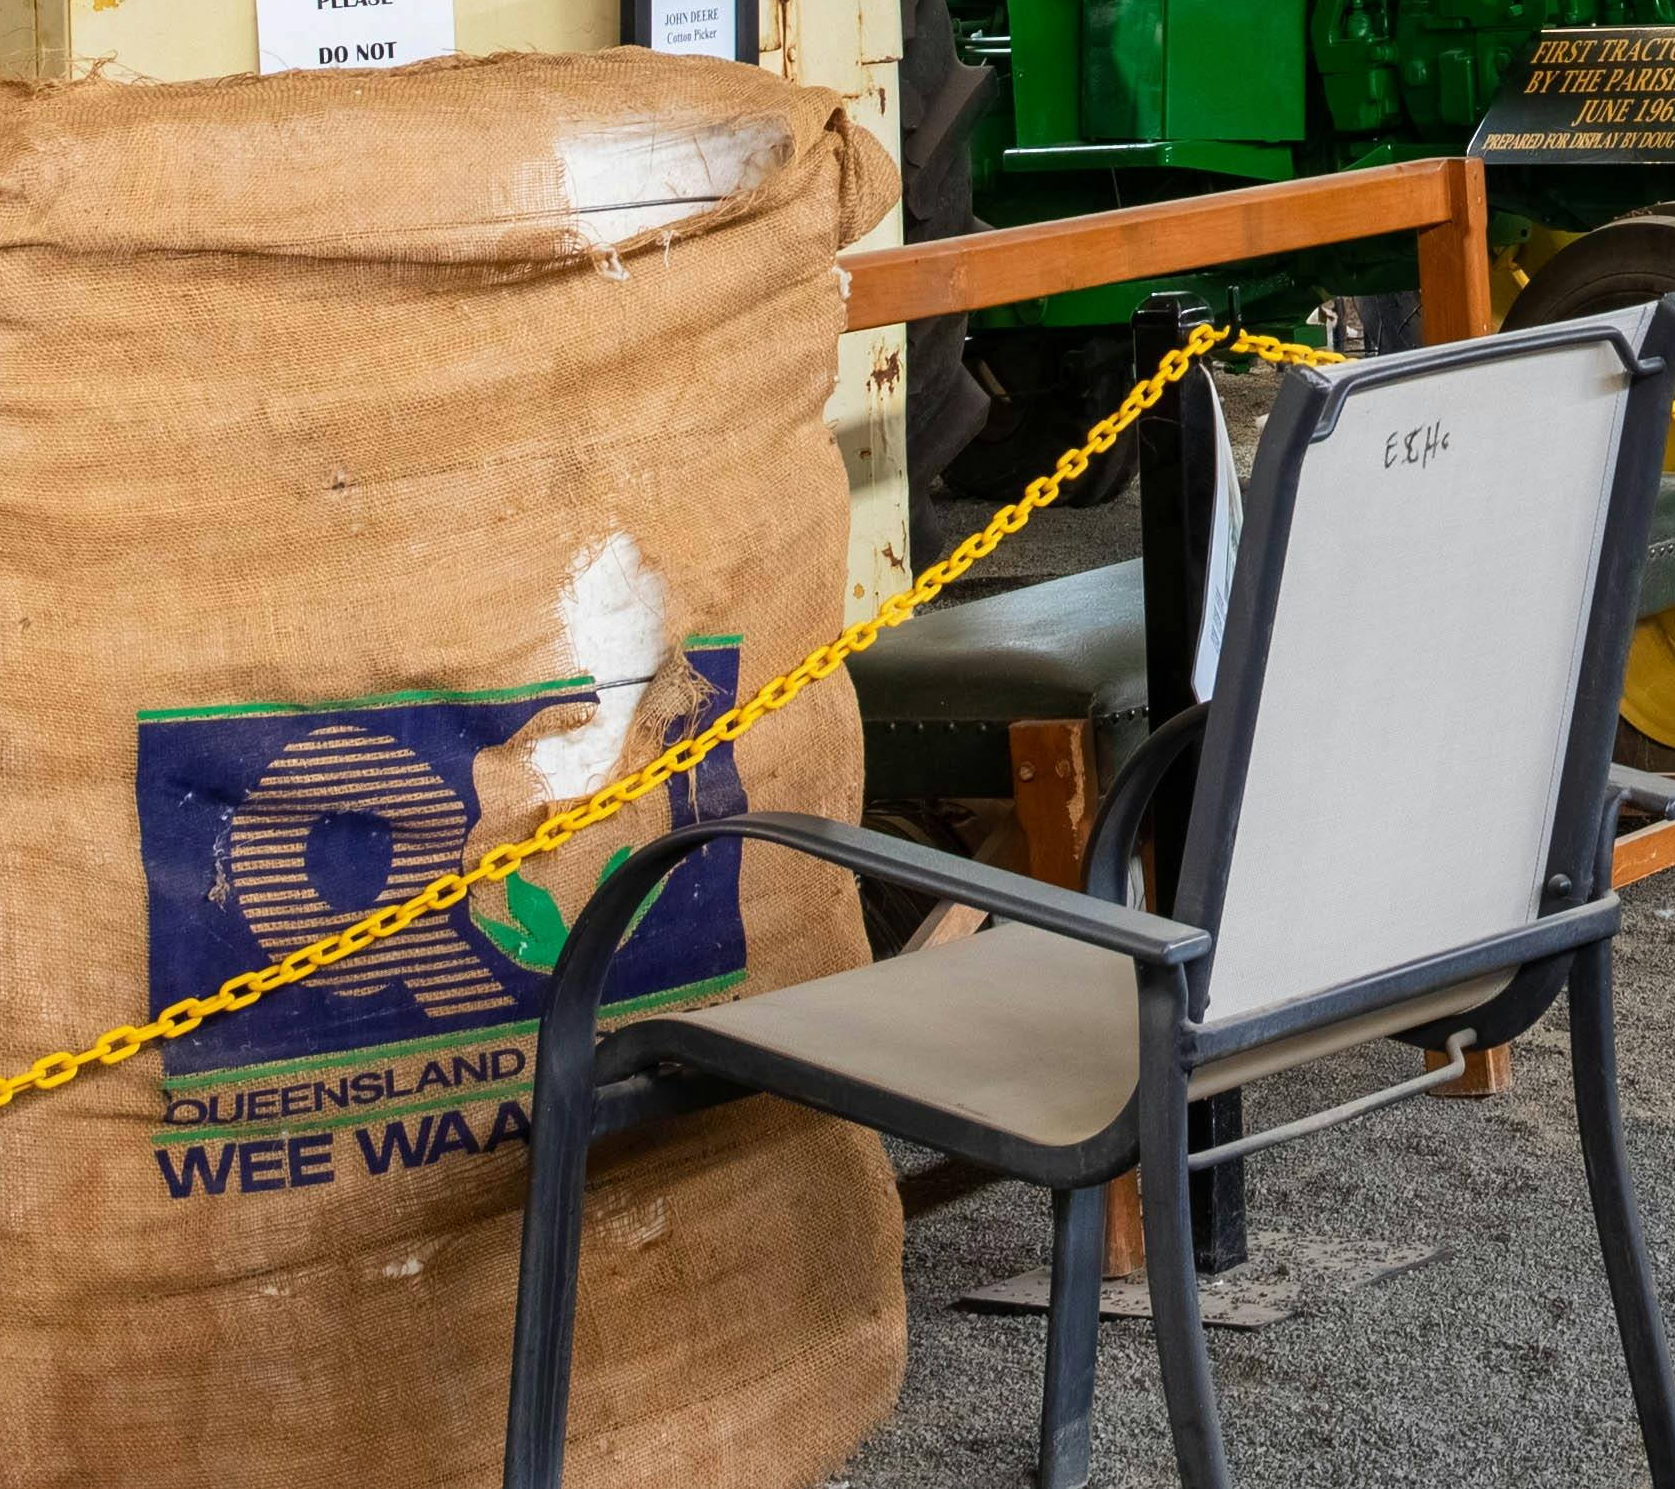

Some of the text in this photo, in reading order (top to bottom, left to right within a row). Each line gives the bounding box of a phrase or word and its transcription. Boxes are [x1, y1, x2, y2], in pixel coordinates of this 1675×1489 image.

[664, 7, 720, 26] JOHN DEERE
[667, 27, 718, 45] Cotton Picker
[318, 41, 398, 65] DO NOT
[1530, 38, 1597, 65] FIRST
[1524, 70, 1562, 96] BY
[1561, 68, 1610, 94] THE
[1571, 98, 1637, 127] JUNE
[1482, 132, 1551, 151] PREPARED
[1545, 132, 1572, 150] FOR
[1569, 132, 1627, 150] DISPLAY
[1622, 132, 1645, 150] BY
[164, 1047, 528, 1126] QUEENSLAND
[156, 1132, 336, 1199] WEE
[355, 1100, 532, 1176] WAA
